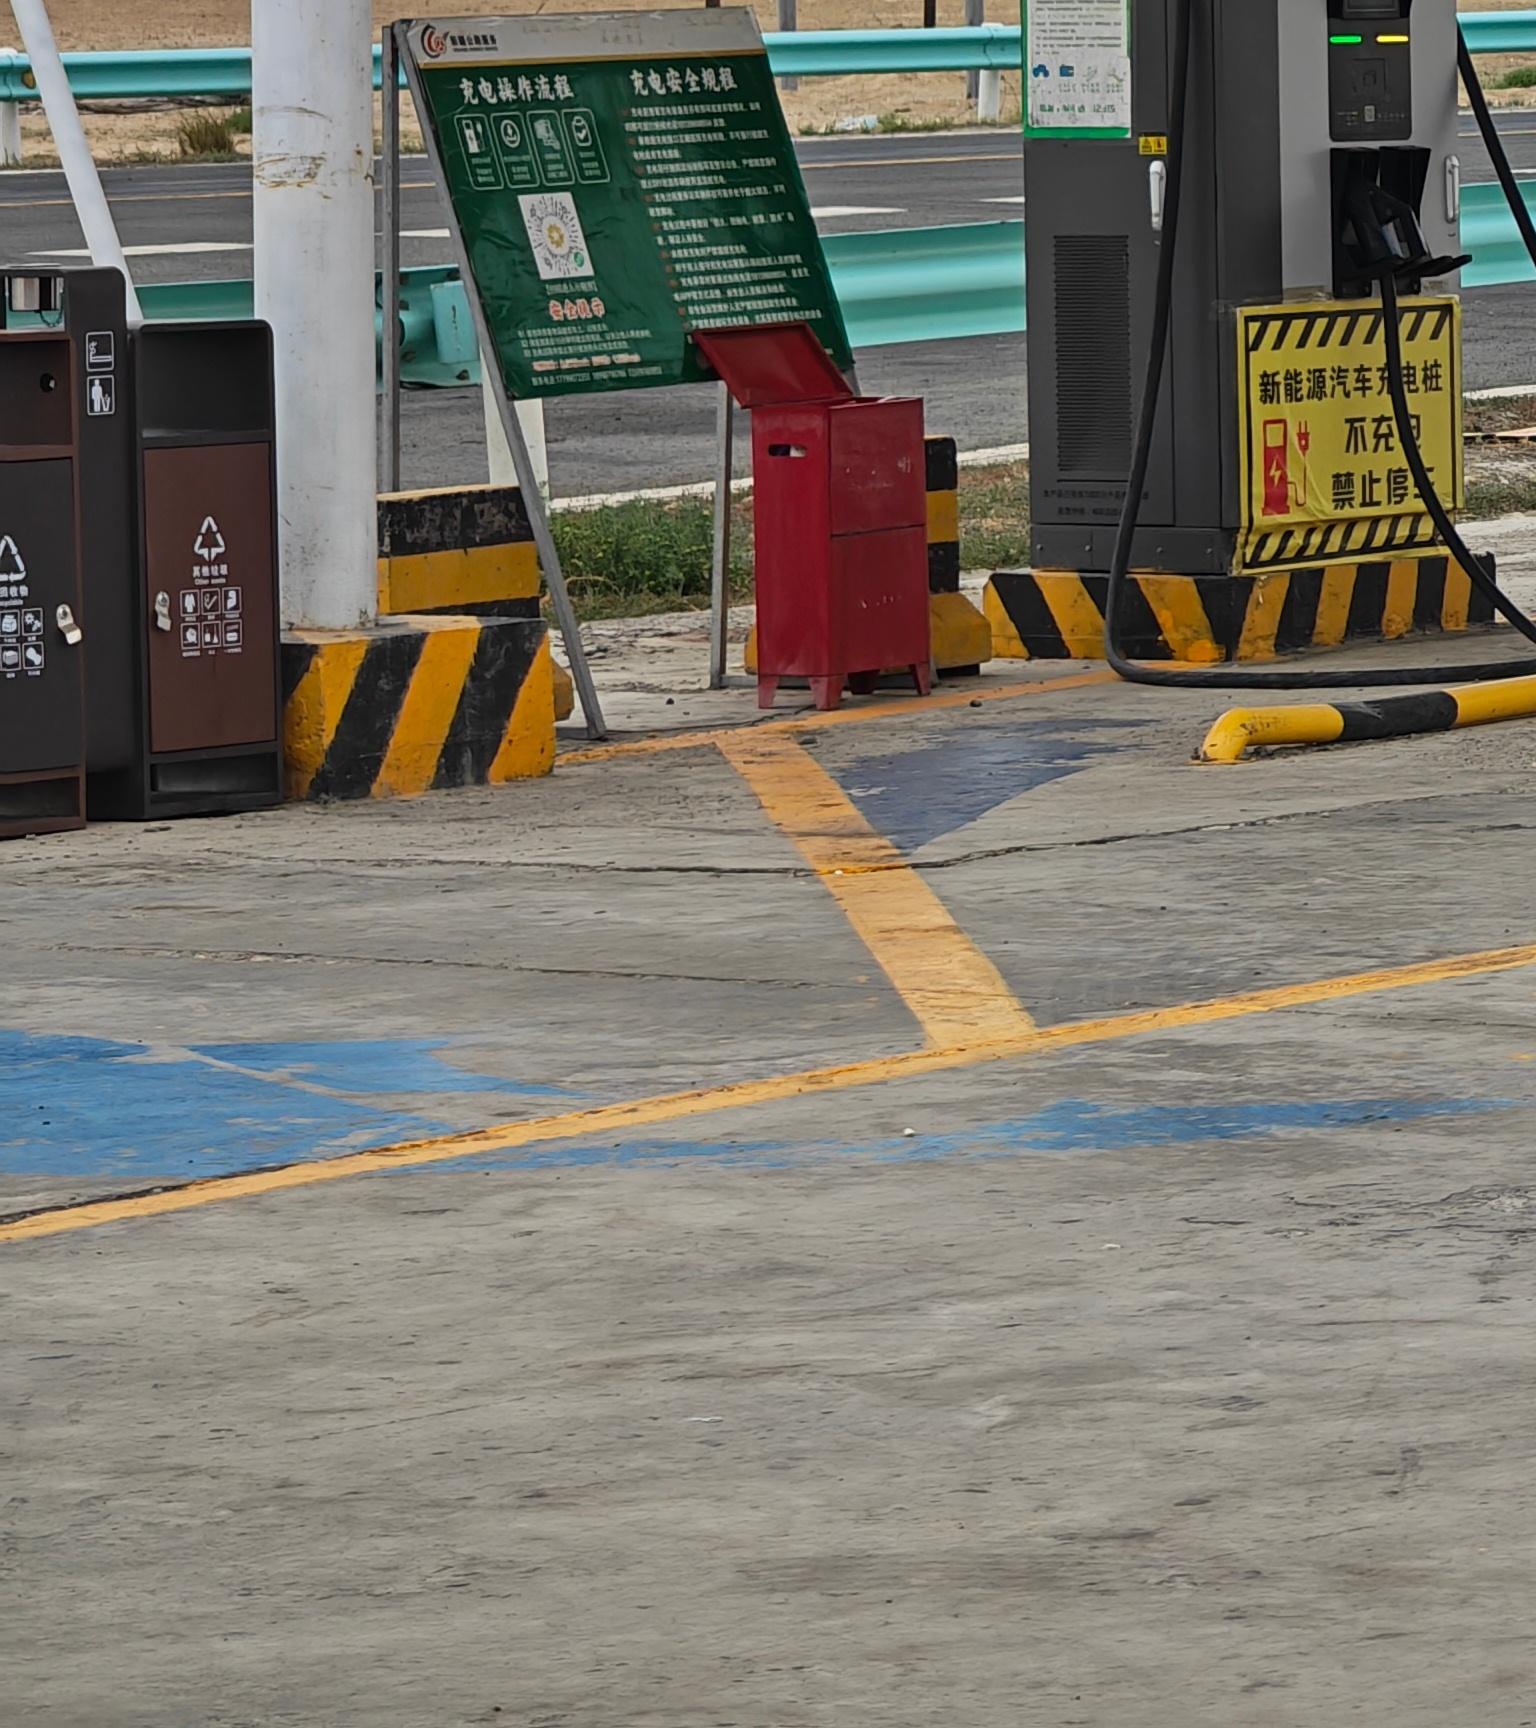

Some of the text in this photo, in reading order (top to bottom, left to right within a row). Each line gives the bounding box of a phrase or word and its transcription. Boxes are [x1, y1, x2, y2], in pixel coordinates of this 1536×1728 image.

[459, 74, 575, 105] 充电操作流程
[629, 66, 738, 97] 充电安全规程
[1259, 358, 1443, 405] 新能源汽车充电桩
